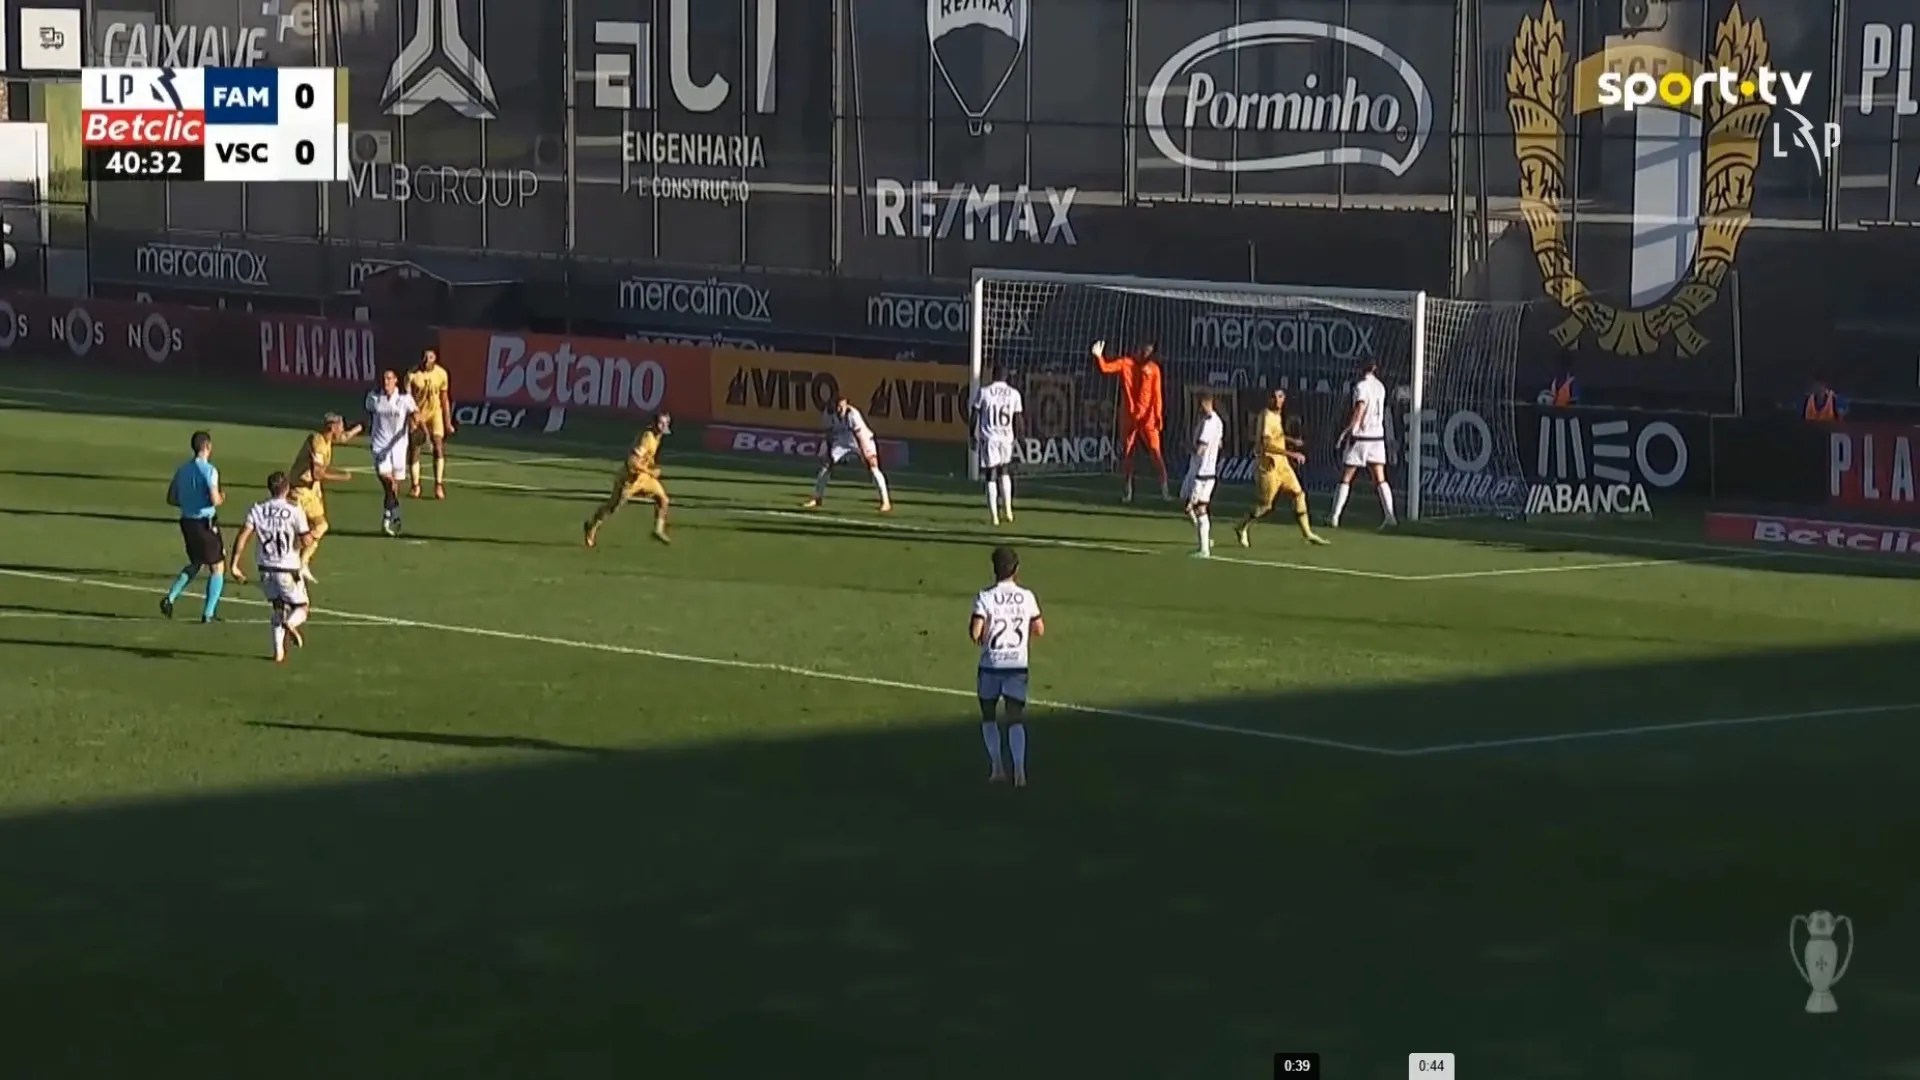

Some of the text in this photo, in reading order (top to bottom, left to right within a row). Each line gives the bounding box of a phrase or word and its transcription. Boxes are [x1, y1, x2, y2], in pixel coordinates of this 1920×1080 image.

[1184, 72, 1400, 133] Porminho
[623, 132, 766, 168] ENGENHARIA
[652, 175, 750, 207] CONSTRUÇÃO
[876, 178, 1077, 245] RE/MAX
[51, 307, 105, 356] NOS
[128, 312, 182, 363] NOS
[260, 320, 376, 381] PLACARD
[485, 335, 666, 412] Betano
[452, 401, 527, 428] aier
[992, 404, 1011, 427] 16
[1829, 432, 1914, 502] PLA
[994, 592, 1024, 605] UZO
[990, 617, 1023, 650] 23
